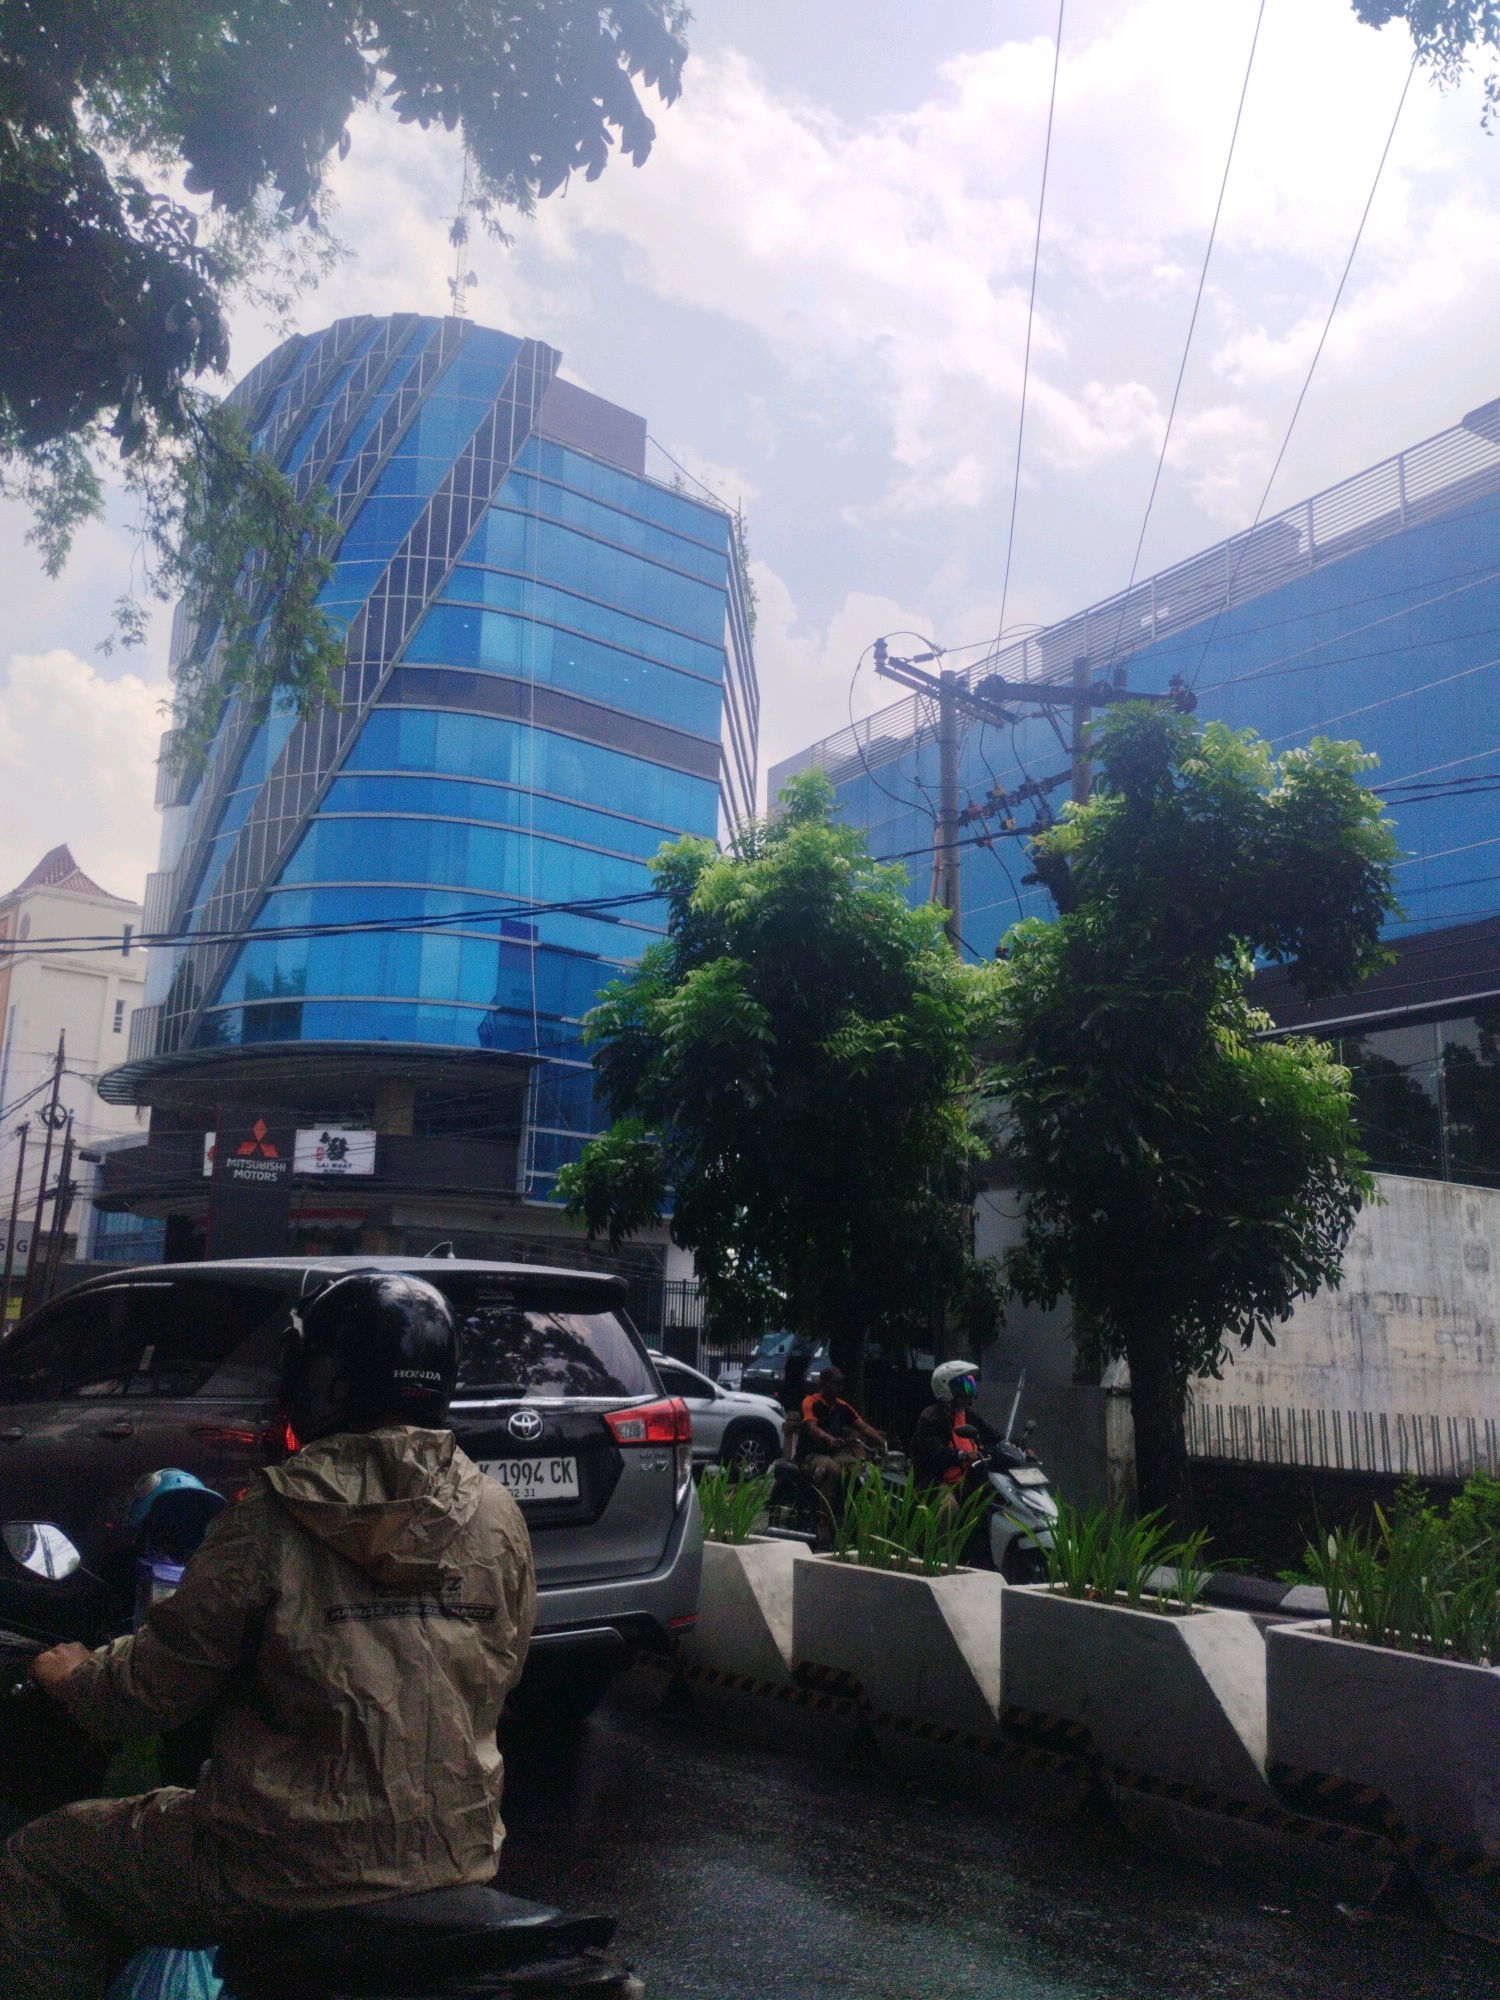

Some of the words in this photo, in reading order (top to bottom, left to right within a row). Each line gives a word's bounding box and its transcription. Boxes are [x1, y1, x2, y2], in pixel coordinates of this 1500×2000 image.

[227, 1158, 286, 1173] MITSUBISHI
[233, 1169, 278, 1182] MOTORS
[393, 1369, 441, 1381] HONDA
[498, 1462, 545, 1486] 1994
[551, 1460, 573, 1484] CK
